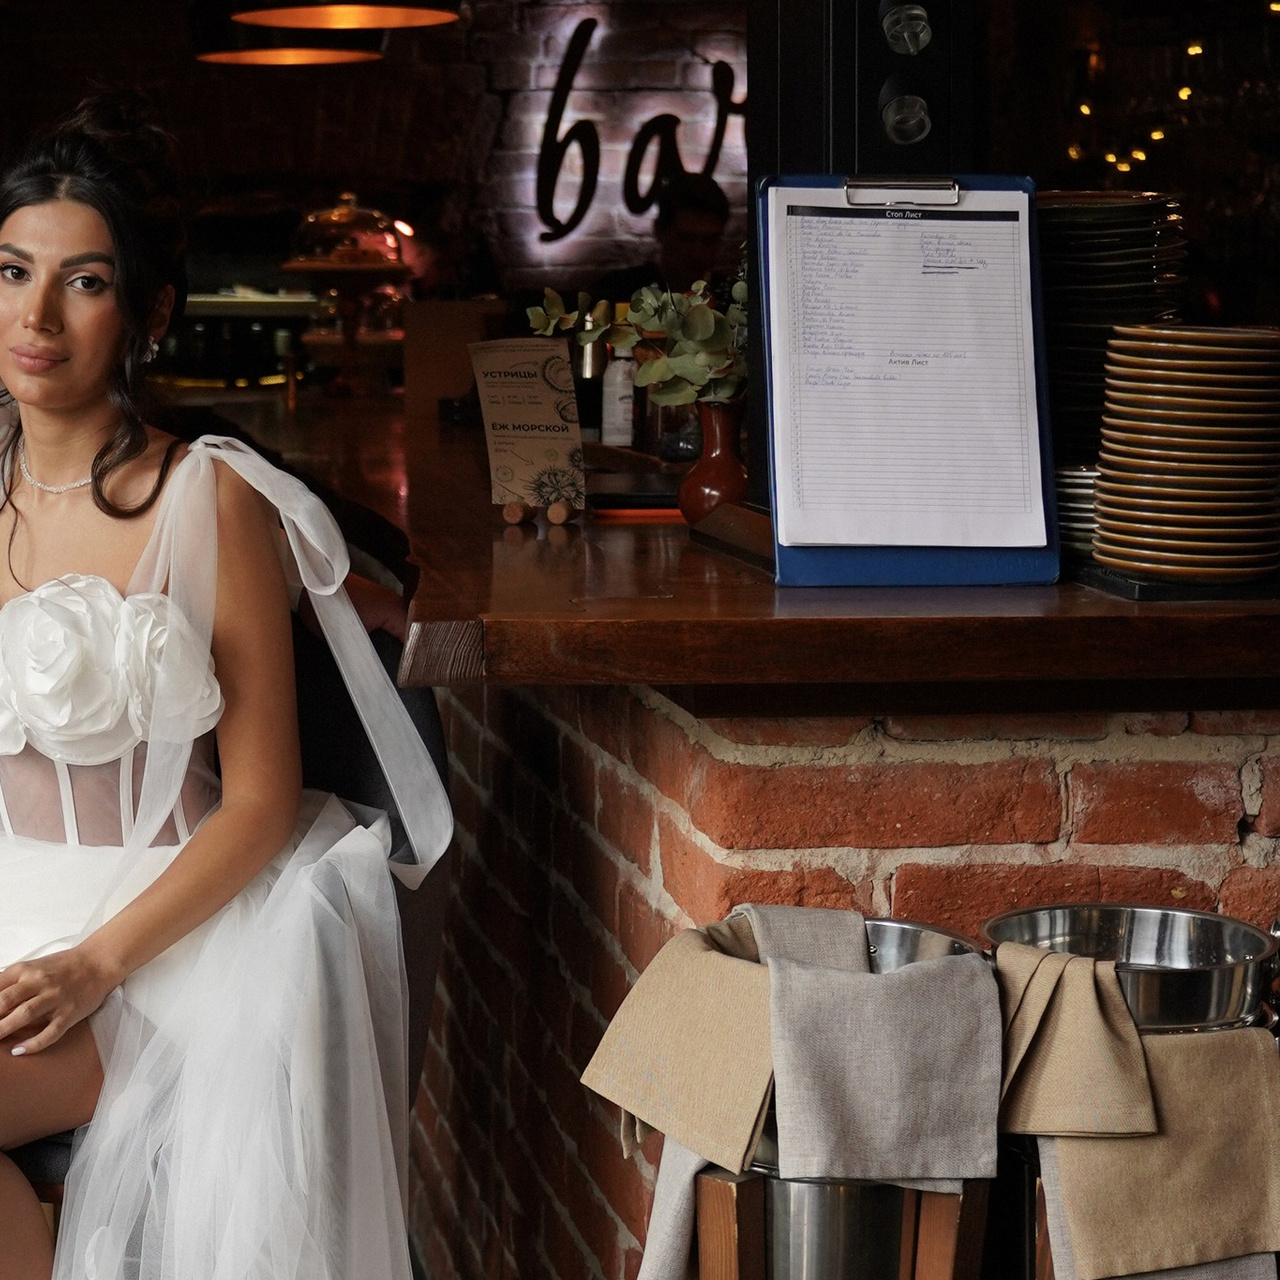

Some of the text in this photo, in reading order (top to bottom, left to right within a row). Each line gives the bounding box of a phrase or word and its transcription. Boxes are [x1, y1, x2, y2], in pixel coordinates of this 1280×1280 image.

[885, 210, 922, 219] Стоп Лист
[482, 371, 537, 379] УСТРИЦЫ
[513, 424, 569, 433] МОРСКОЙ
